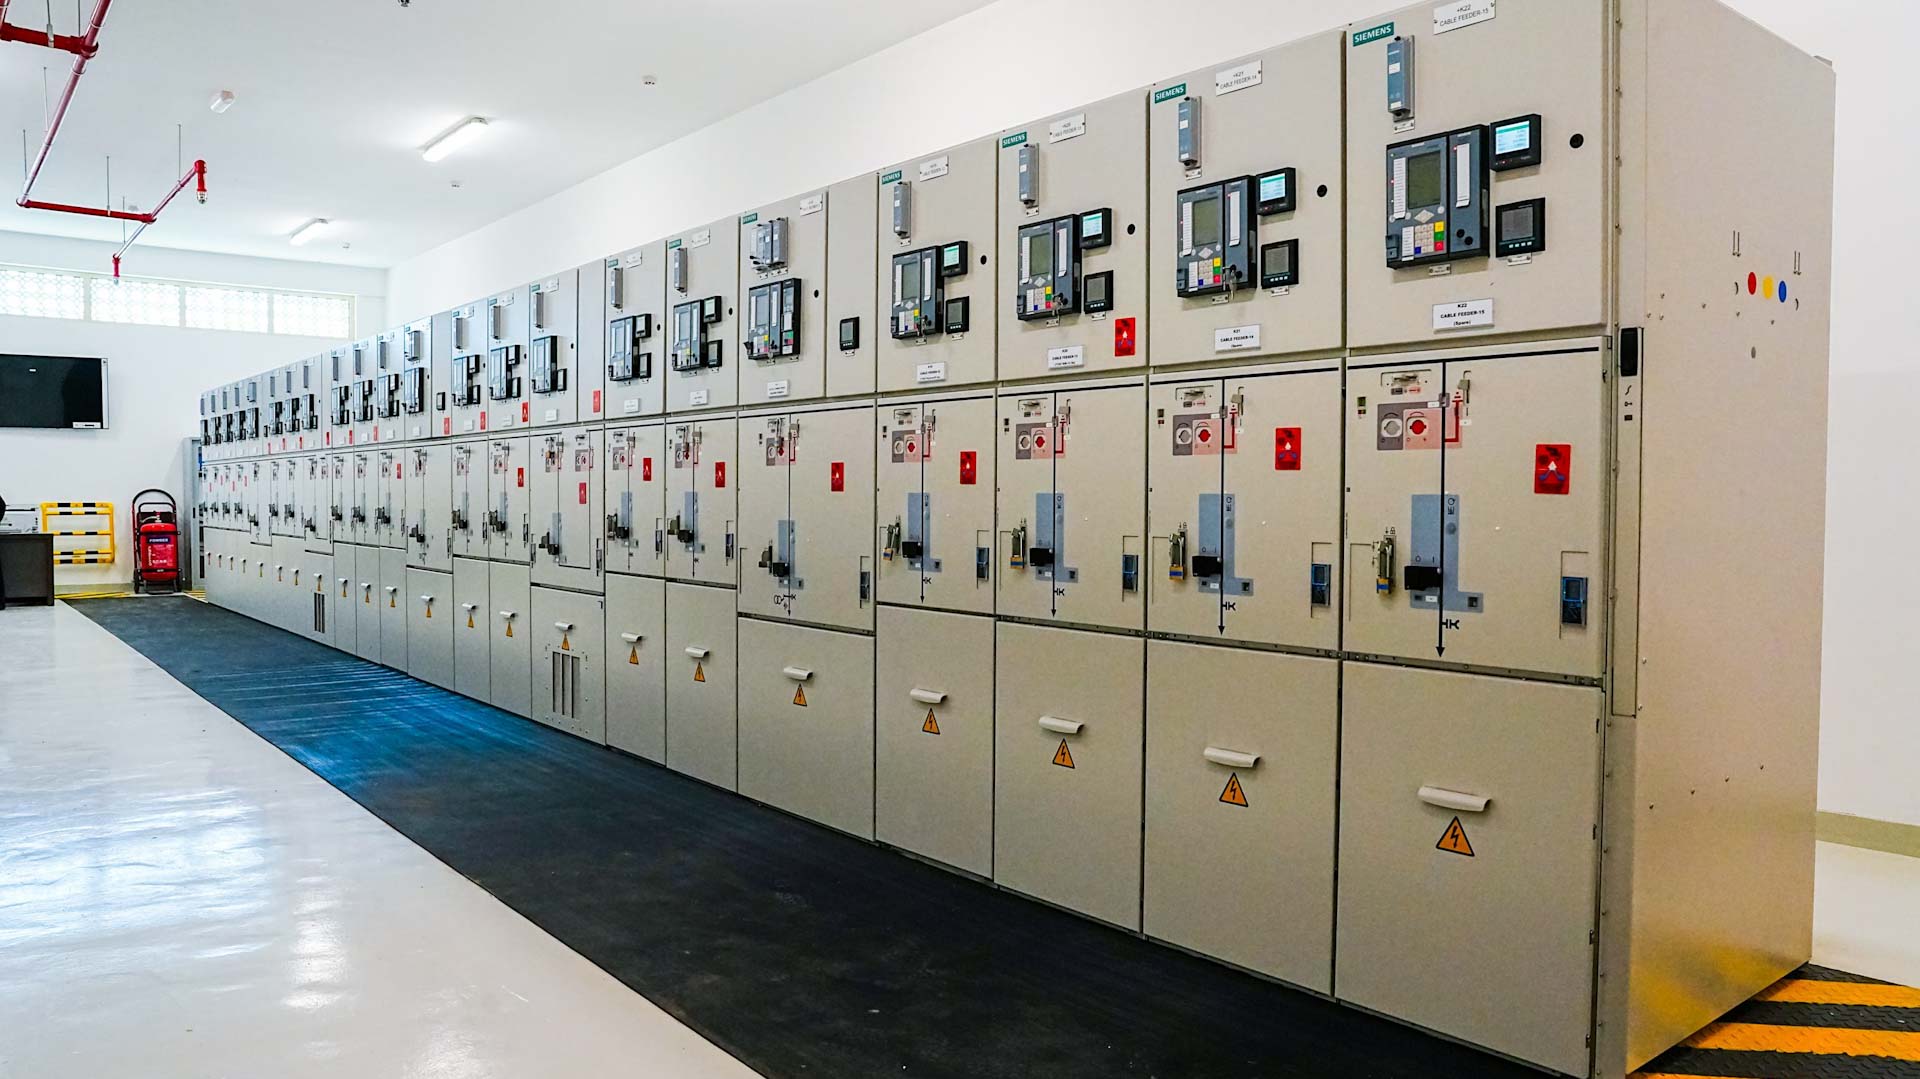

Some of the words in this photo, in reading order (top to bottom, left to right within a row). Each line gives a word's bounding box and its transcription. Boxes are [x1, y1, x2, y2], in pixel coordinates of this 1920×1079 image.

[1456, 4, 1471, 12] +K22
[1439, 16, 1458, 27] CABLE
[1458, 8, 1489, 22] FEEDER-15
[1353, 25, 1392, 44] SIEMENS
[1219, 80, 1233, 90] CABLE
[1155, 86, 1184, 101] SIEMENS
[1003, 133, 1025, 146] SIEMENS
[882, 171, 901, 183] SIEMENS
